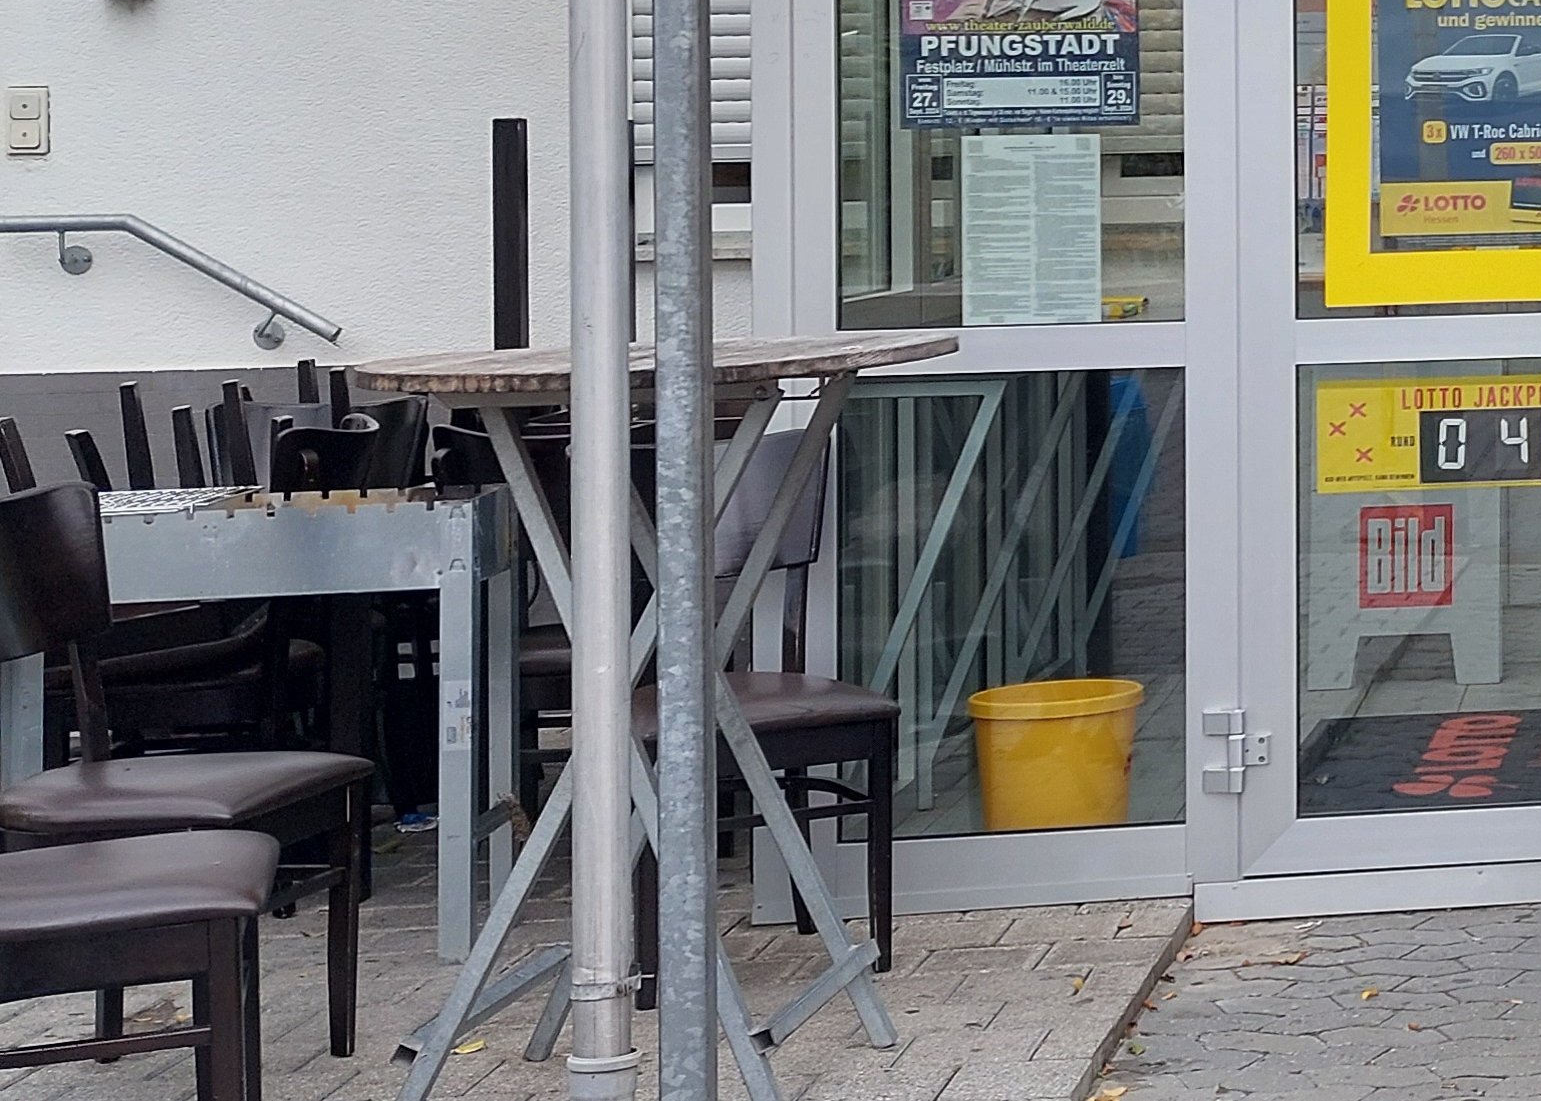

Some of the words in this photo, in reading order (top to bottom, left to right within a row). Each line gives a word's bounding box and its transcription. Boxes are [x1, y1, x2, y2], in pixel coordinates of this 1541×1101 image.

[925, 18, 1115, 32] www.theater-zauberwald.de
[1438, 13, 1469, 28] und
[920, 34, 1120, 57] PFUNGSTADT
[916, 59, 974, 75] Festplatz
[984, 58, 1034, 73] Mühlstr.
[1037, 59, 1053, 72] im
[1055, 58, 1125, 73] Theaterzelt
[912, 92, 937, 108] 27.
[1106, 89, 1131, 105] 29.
[1450, 124, 1469, 139] VW
[1472, 124, 1506, 139] T-Roc
[1495, 146, 1516, 161] 260
[1520, 150, 1526, 160] x
[1423, 194, 1487, 212] LOTTO
[1423, 213, 1459, 224] Hessen
[1401, 386, 1462, 410] LOTTO
[1391, 435, 1415, 447] RUND
[1367, 516, 1446, 594] Bild
